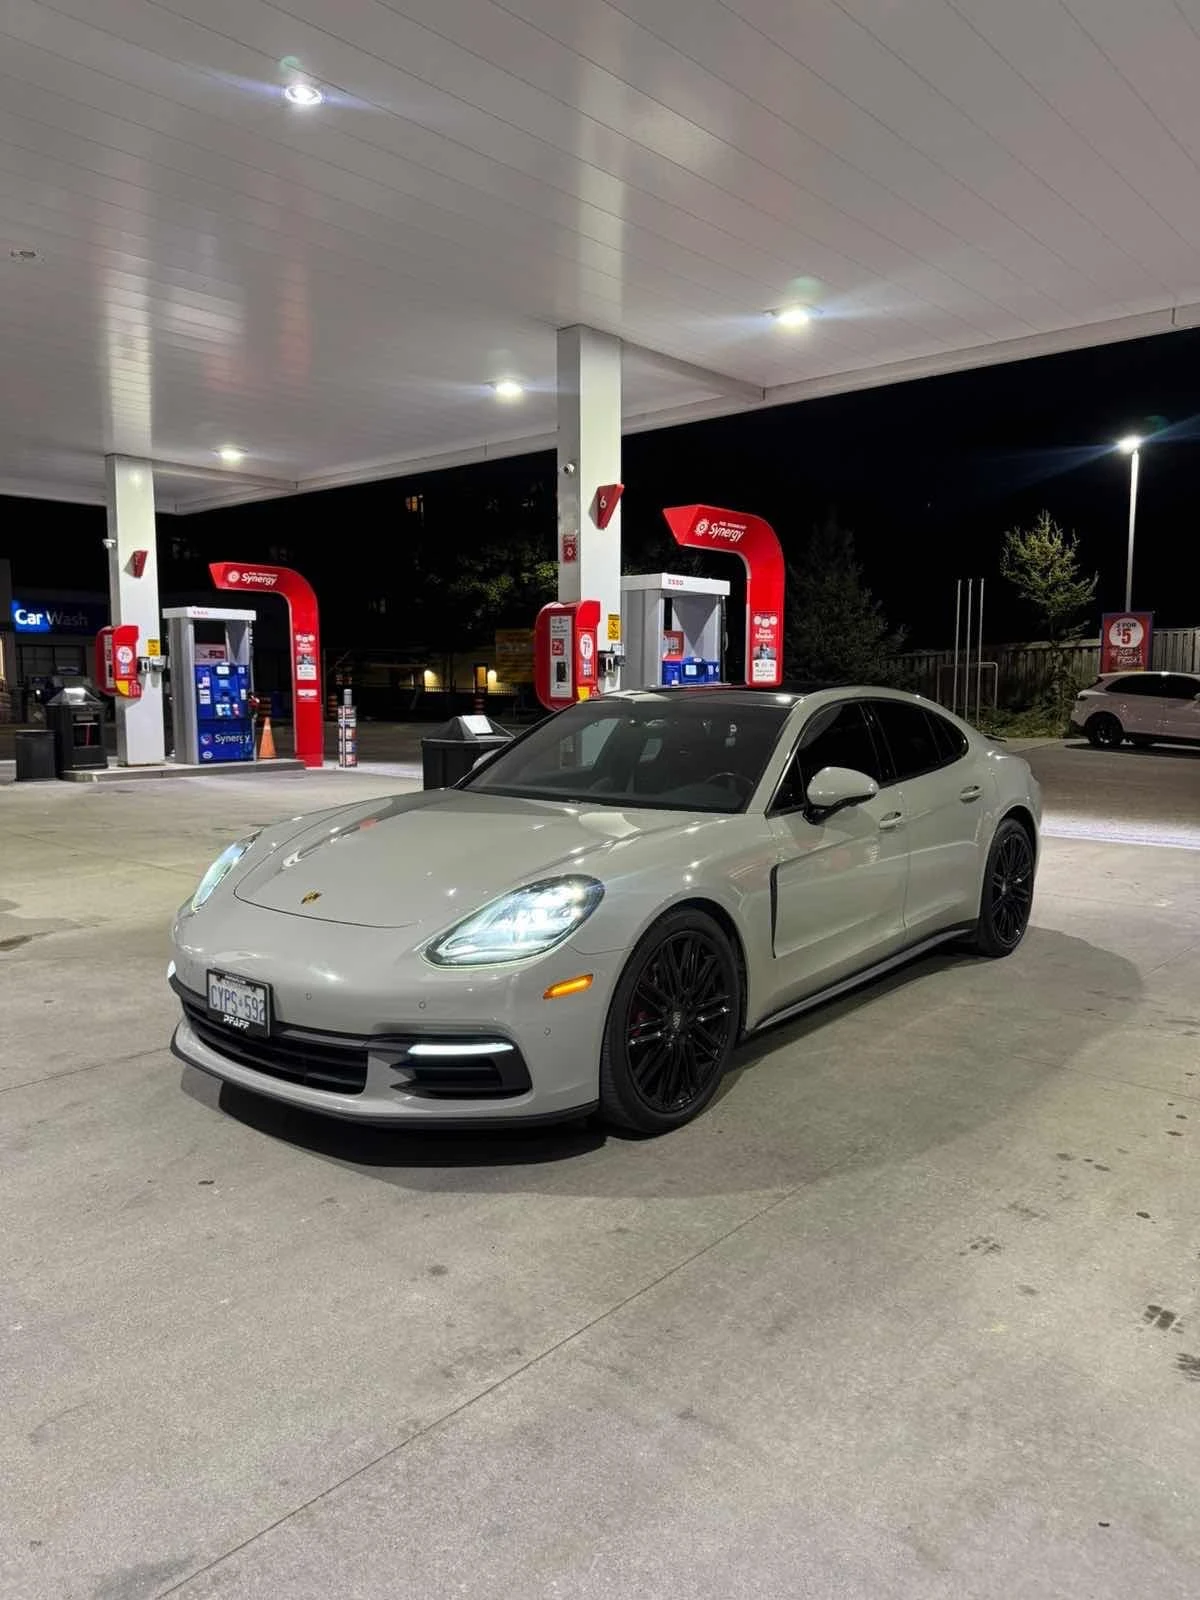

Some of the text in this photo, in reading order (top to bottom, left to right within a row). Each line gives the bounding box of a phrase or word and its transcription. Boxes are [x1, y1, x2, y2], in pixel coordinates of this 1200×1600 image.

[600, 496, 607, 508] 6
[708, 523, 744, 542] Synergy
[241, 573, 278, 585] Synergy
[15, 609, 88, 626] Car Wash
[215, 734, 250, 744] Synergy
[211, 984, 238, 1015] CYPS
[223, 1014, 250, 1029] PFAFF
